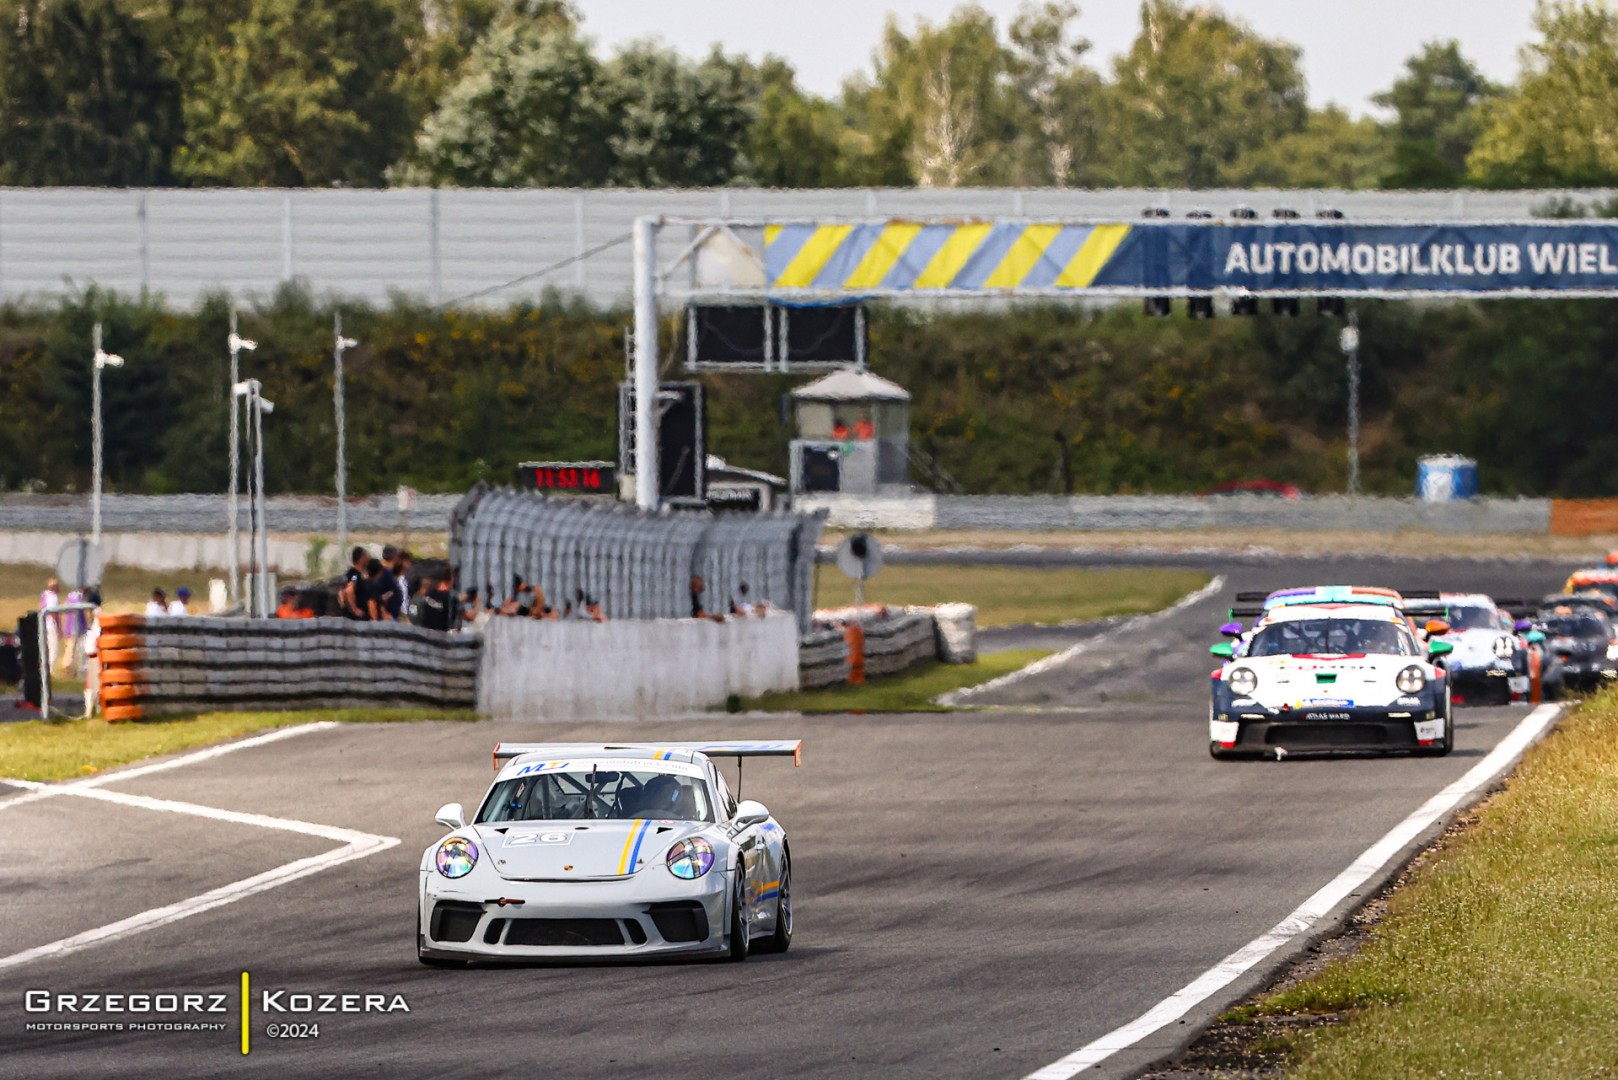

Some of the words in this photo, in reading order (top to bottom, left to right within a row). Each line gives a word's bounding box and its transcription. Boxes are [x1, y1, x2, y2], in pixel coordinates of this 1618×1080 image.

[1223, 241, 1521, 275] AUTOMOBILKLUB
[1527, 242, 1618, 275] WIEL
[508, 832, 568, 845] 26
